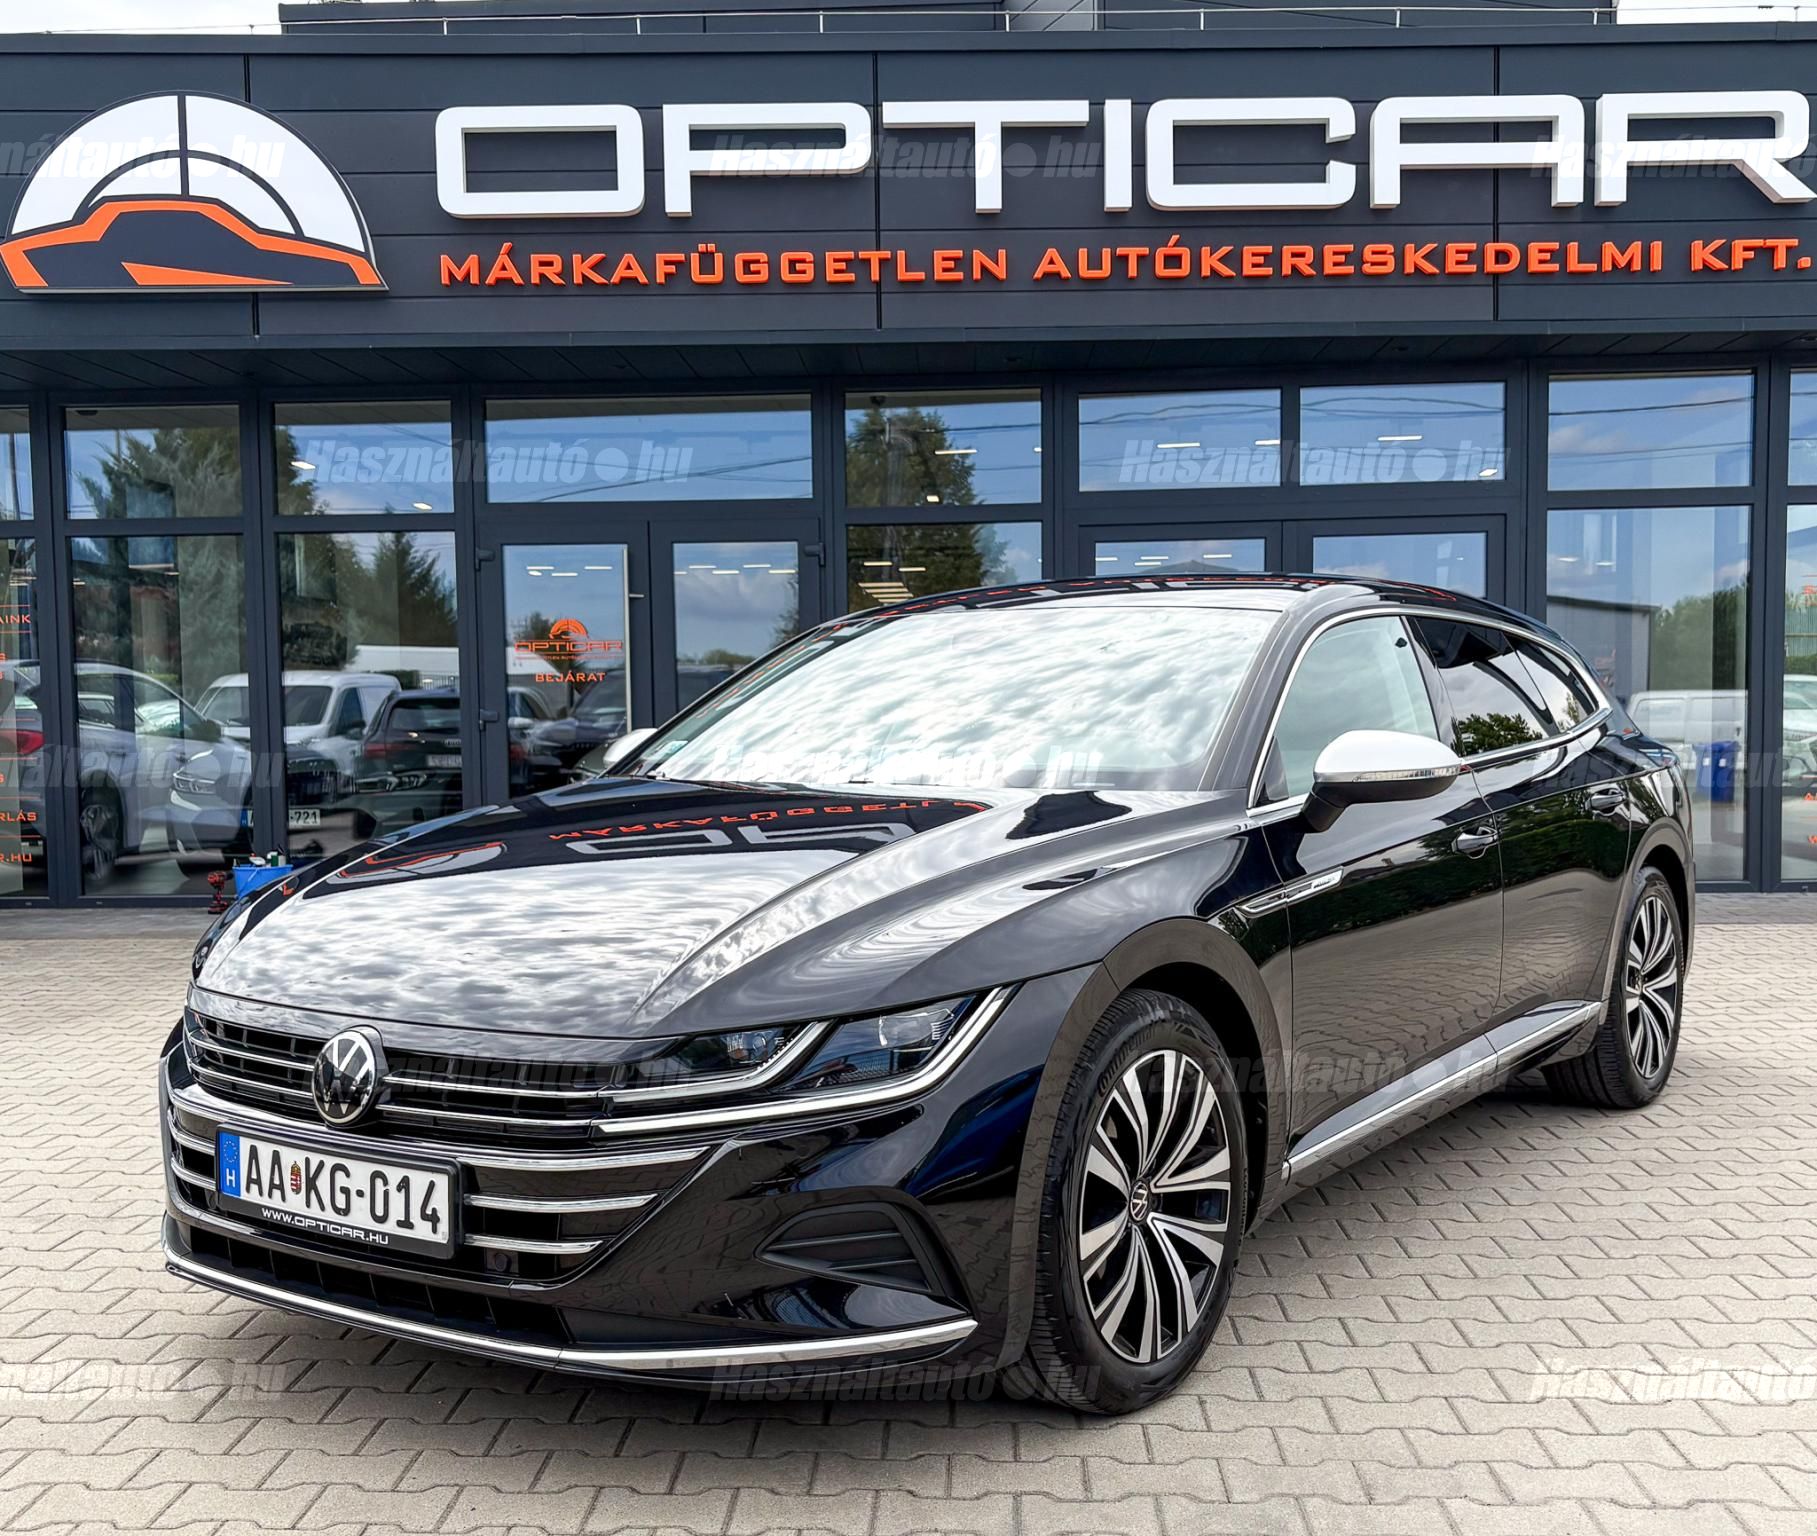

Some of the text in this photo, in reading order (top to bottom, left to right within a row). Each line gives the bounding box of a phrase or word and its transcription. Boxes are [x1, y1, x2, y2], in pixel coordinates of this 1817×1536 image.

[435, 90, 1817, 218] OPTICAR
[439, 235, 1812, 286] MÁRKAFÜGGETLEN AUTÓKERESKEDELMI KFT.
[514, 640, 623, 654] OPTICAR
[535, 669, 606, 683] BEJÁRAT
[225, 1167, 236, 1188] H
[262, 1207, 389, 1245] WWW.OPTICAR.HU
